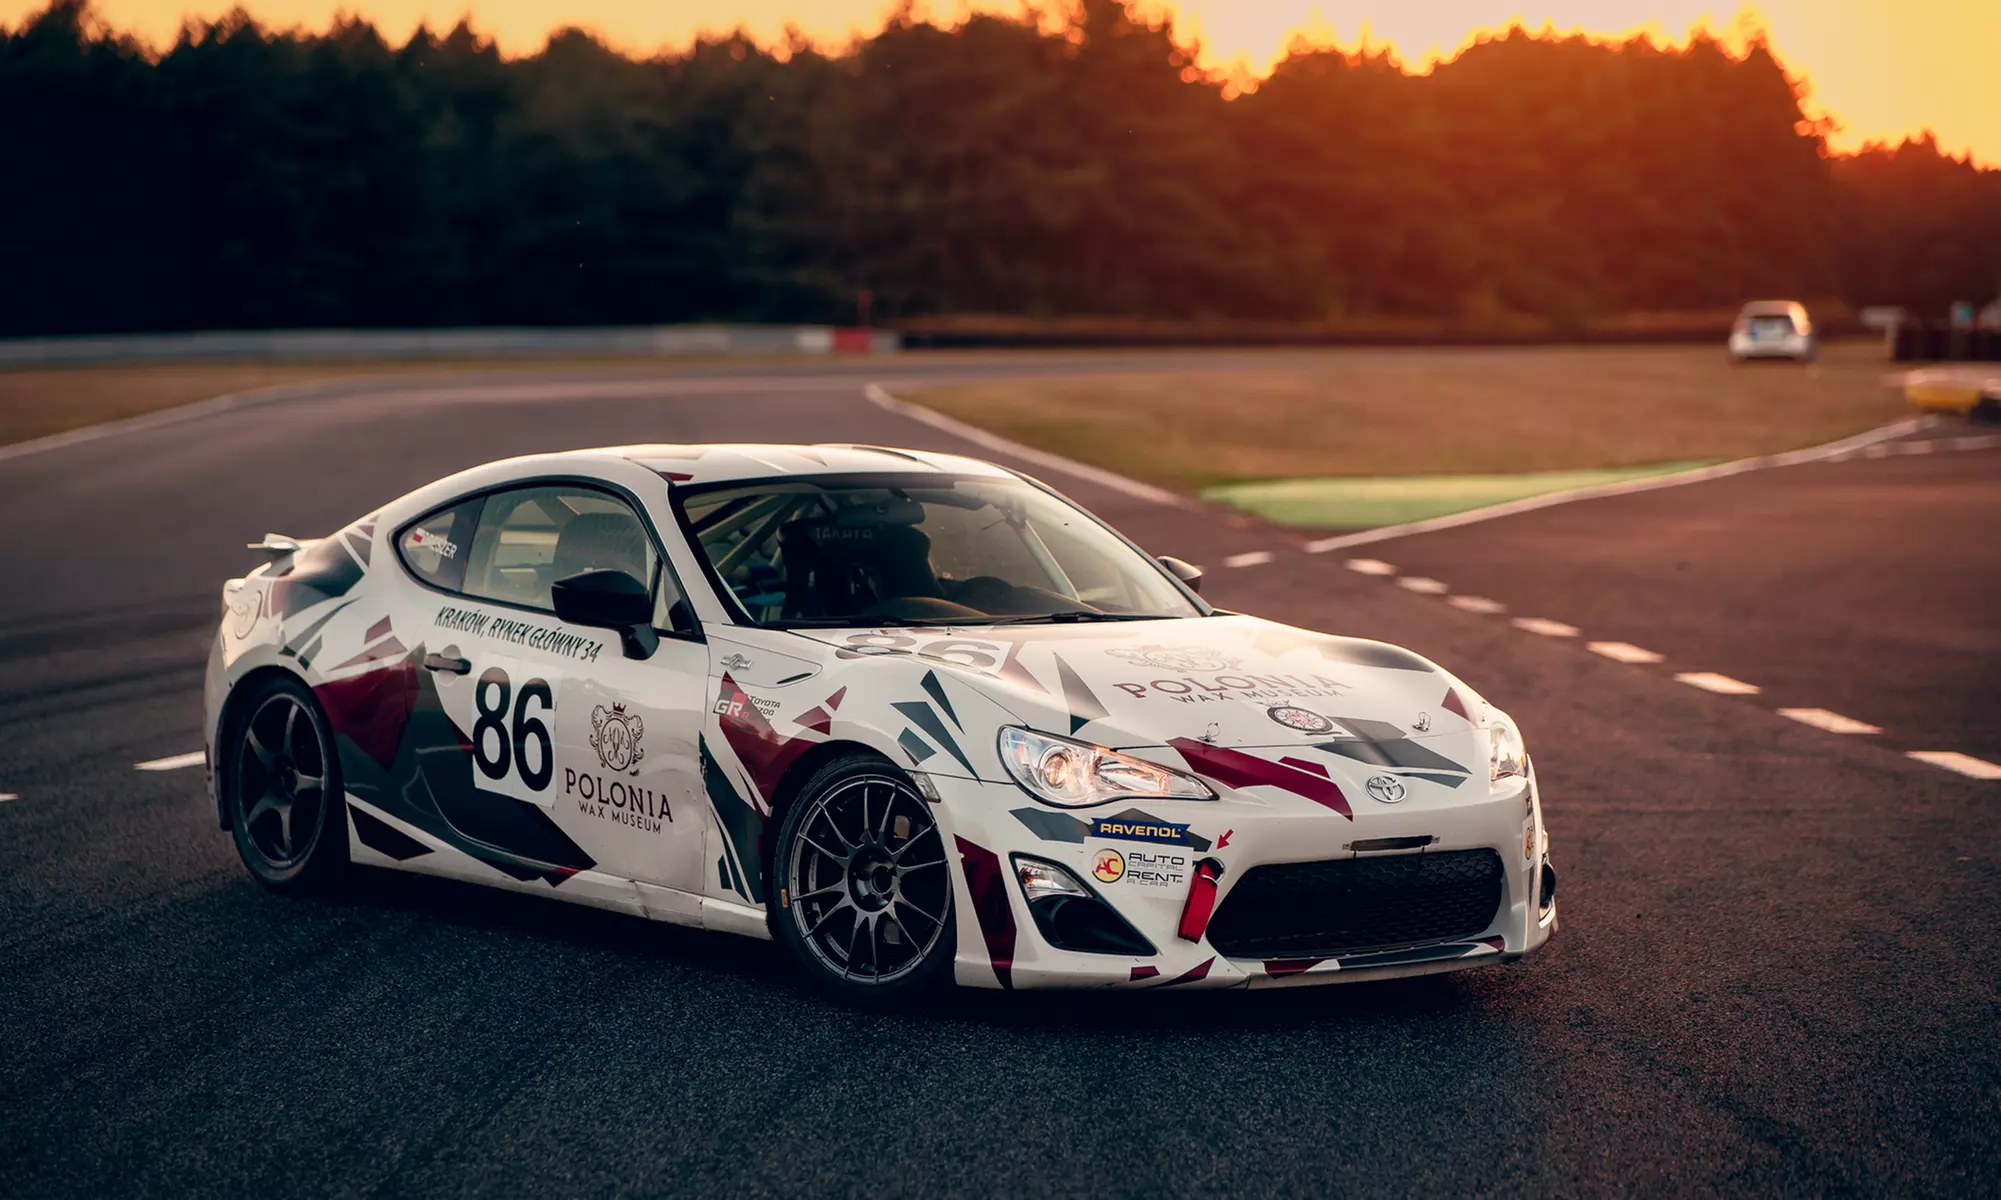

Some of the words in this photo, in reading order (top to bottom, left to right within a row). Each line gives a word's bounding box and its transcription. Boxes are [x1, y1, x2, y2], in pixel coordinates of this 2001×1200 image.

[488, 617, 534, 645] RYNEK
[528, 626, 587, 658] GŁÓWNY
[580, 640, 603, 663] 34
[1112, 674, 1353, 699] POLONIA
[750, 695, 781, 709] TOYOTA
[1170, 691, 1233, 704] WAX
[1240, 688, 1345, 699] MUSEUM
[714, 699, 743, 717] GR
[472, 666, 554, 792] 86
[565, 767, 673, 823] POLONIA
[578, 800, 605, 819] WAX
[612, 809, 661, 835] MUSEUM
[1100, 823, 1181, 838] RAVENOL
[1128, 852, 1185, 866] AUTO
[1128, 861, 1184, 872] CAPITAL
[1127, 870, 1183, 884] RENT
